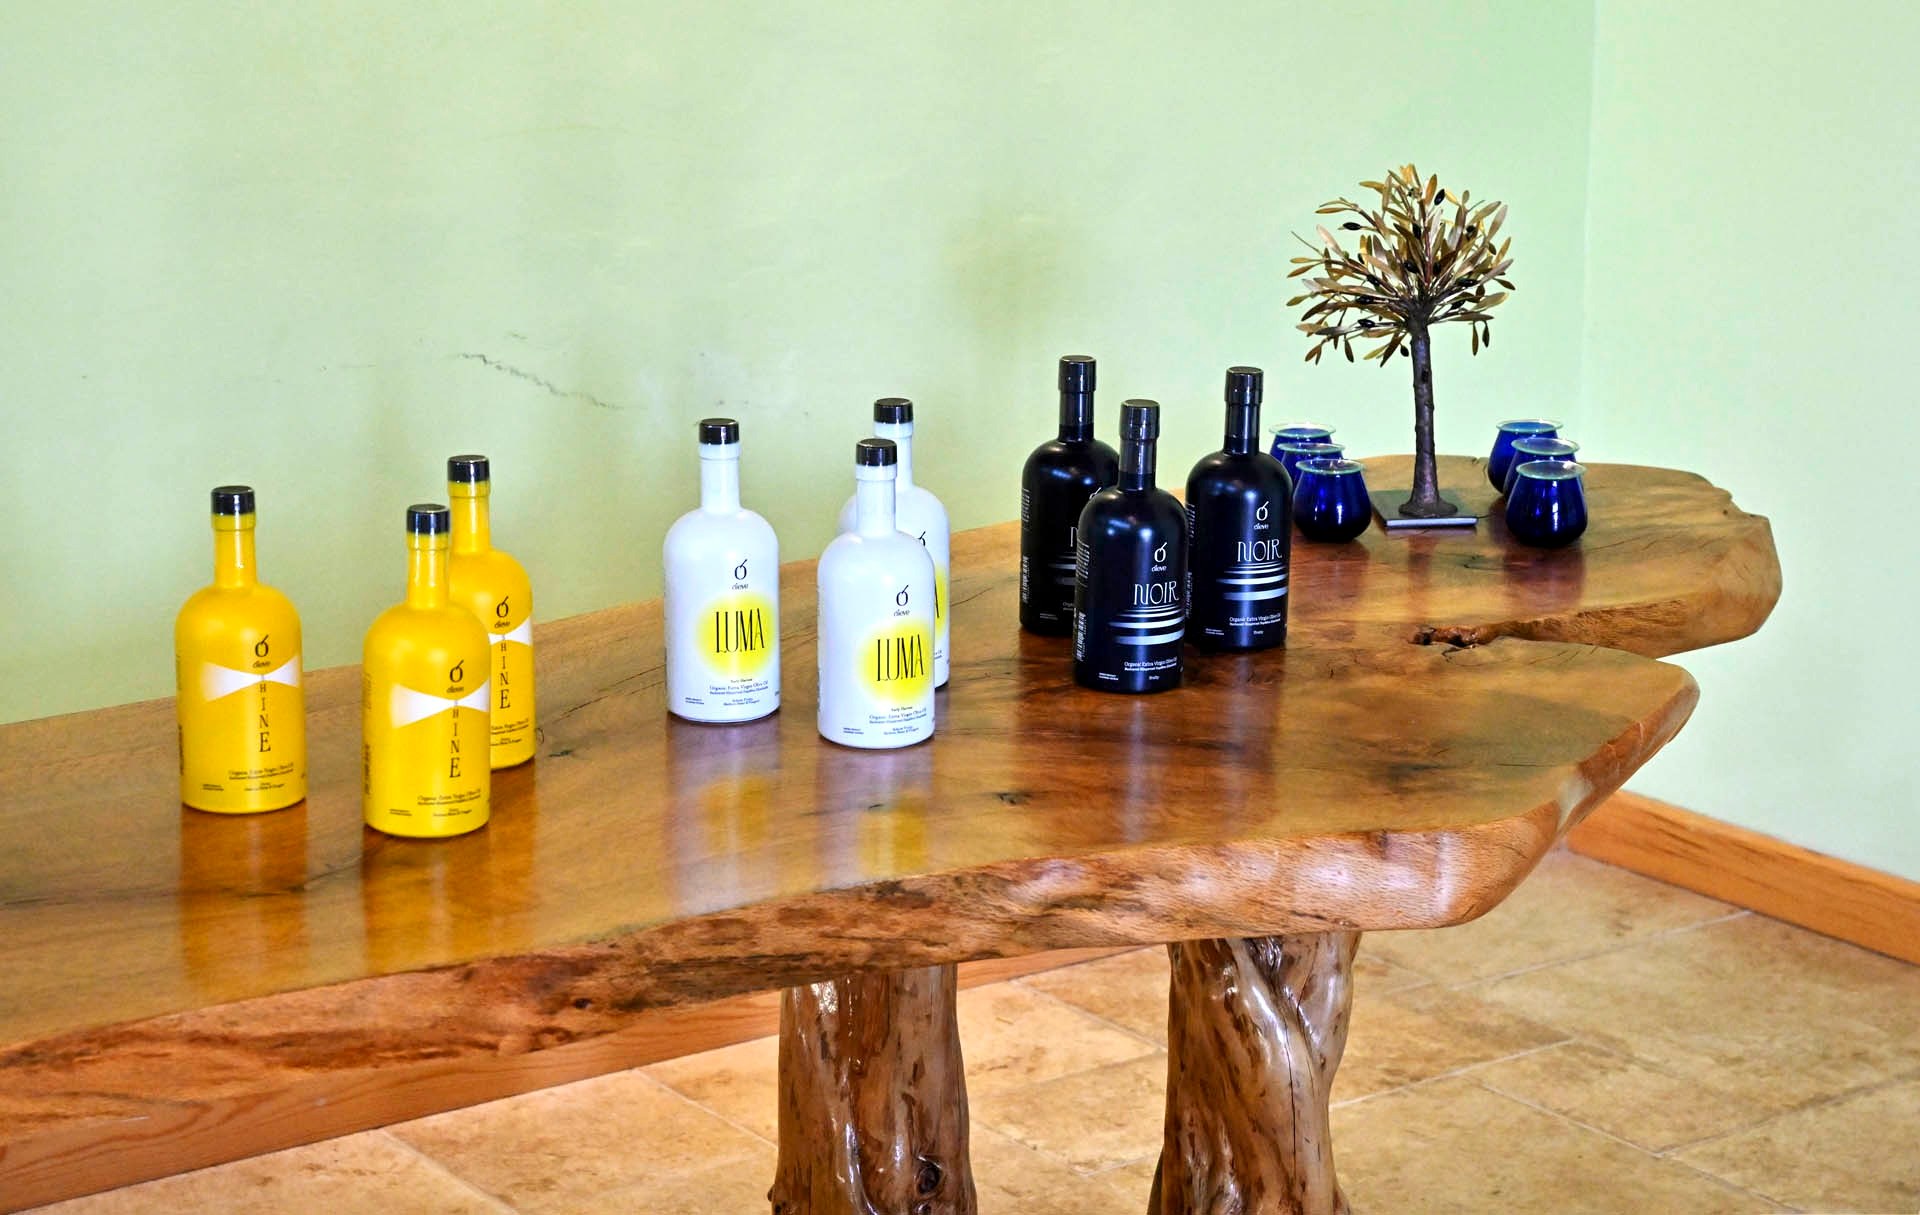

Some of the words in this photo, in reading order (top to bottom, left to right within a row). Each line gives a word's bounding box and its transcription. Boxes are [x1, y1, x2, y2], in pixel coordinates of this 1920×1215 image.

[1237, 538, 1283, 562] NOIR
[1133, 580, 1180, 606] NOIR
[715, 608, 765, 654] LUMA
[876, 634, 924, 682] LUMA
